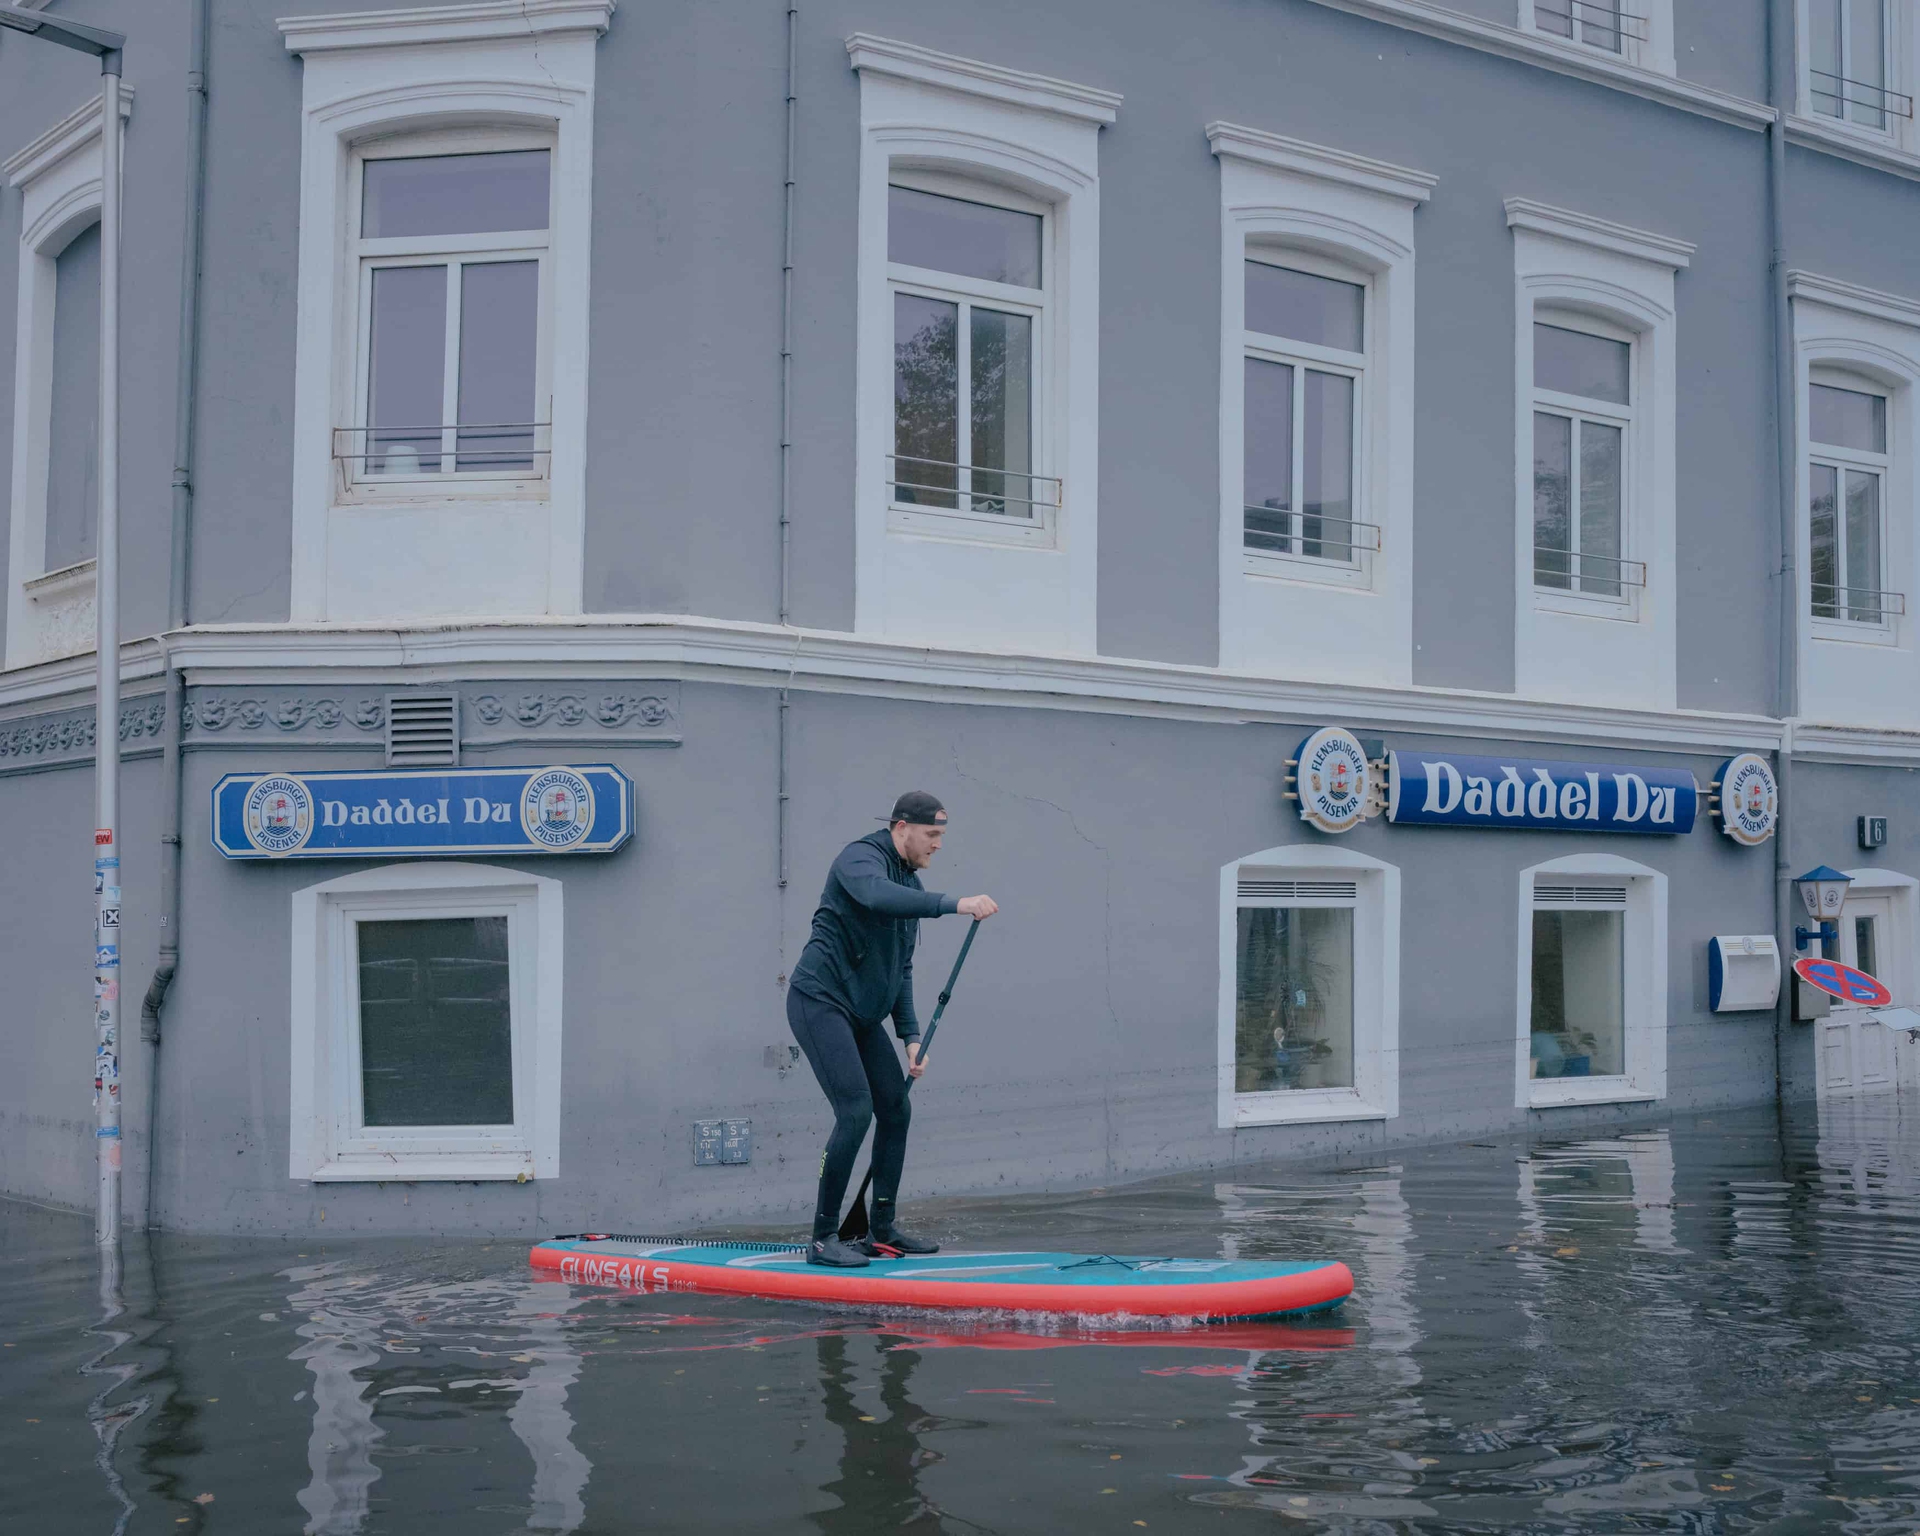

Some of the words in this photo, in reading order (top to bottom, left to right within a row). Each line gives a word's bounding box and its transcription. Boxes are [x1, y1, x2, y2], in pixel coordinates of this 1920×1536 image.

[1311, 739, 1363, 774] FLENSBURGER
[528, 774, 586, 804] FLENSBURGER
[1733, 764, 1774, 795] FLENSBURGER
[251, 781, 306, 811] FLENSBURGER
[1421, 761, 1600, 821] Daddel
[1612, 773, 1677, 824] Du
[321, 798, 451, 827] Daddel
[463, 797, 512, 824] Du
[1317, 795, 1359, 818] PILSENER
[534, 824, 582, 844] PILSENER
[1738, 814, 1771, 832] PILSENER
[1874, 821, 1882, 842] 6
[256, 830, 302, 849] PILSENER
[702, 1126, 710, 1136] S
[730, 1125, 737, 1136] S
